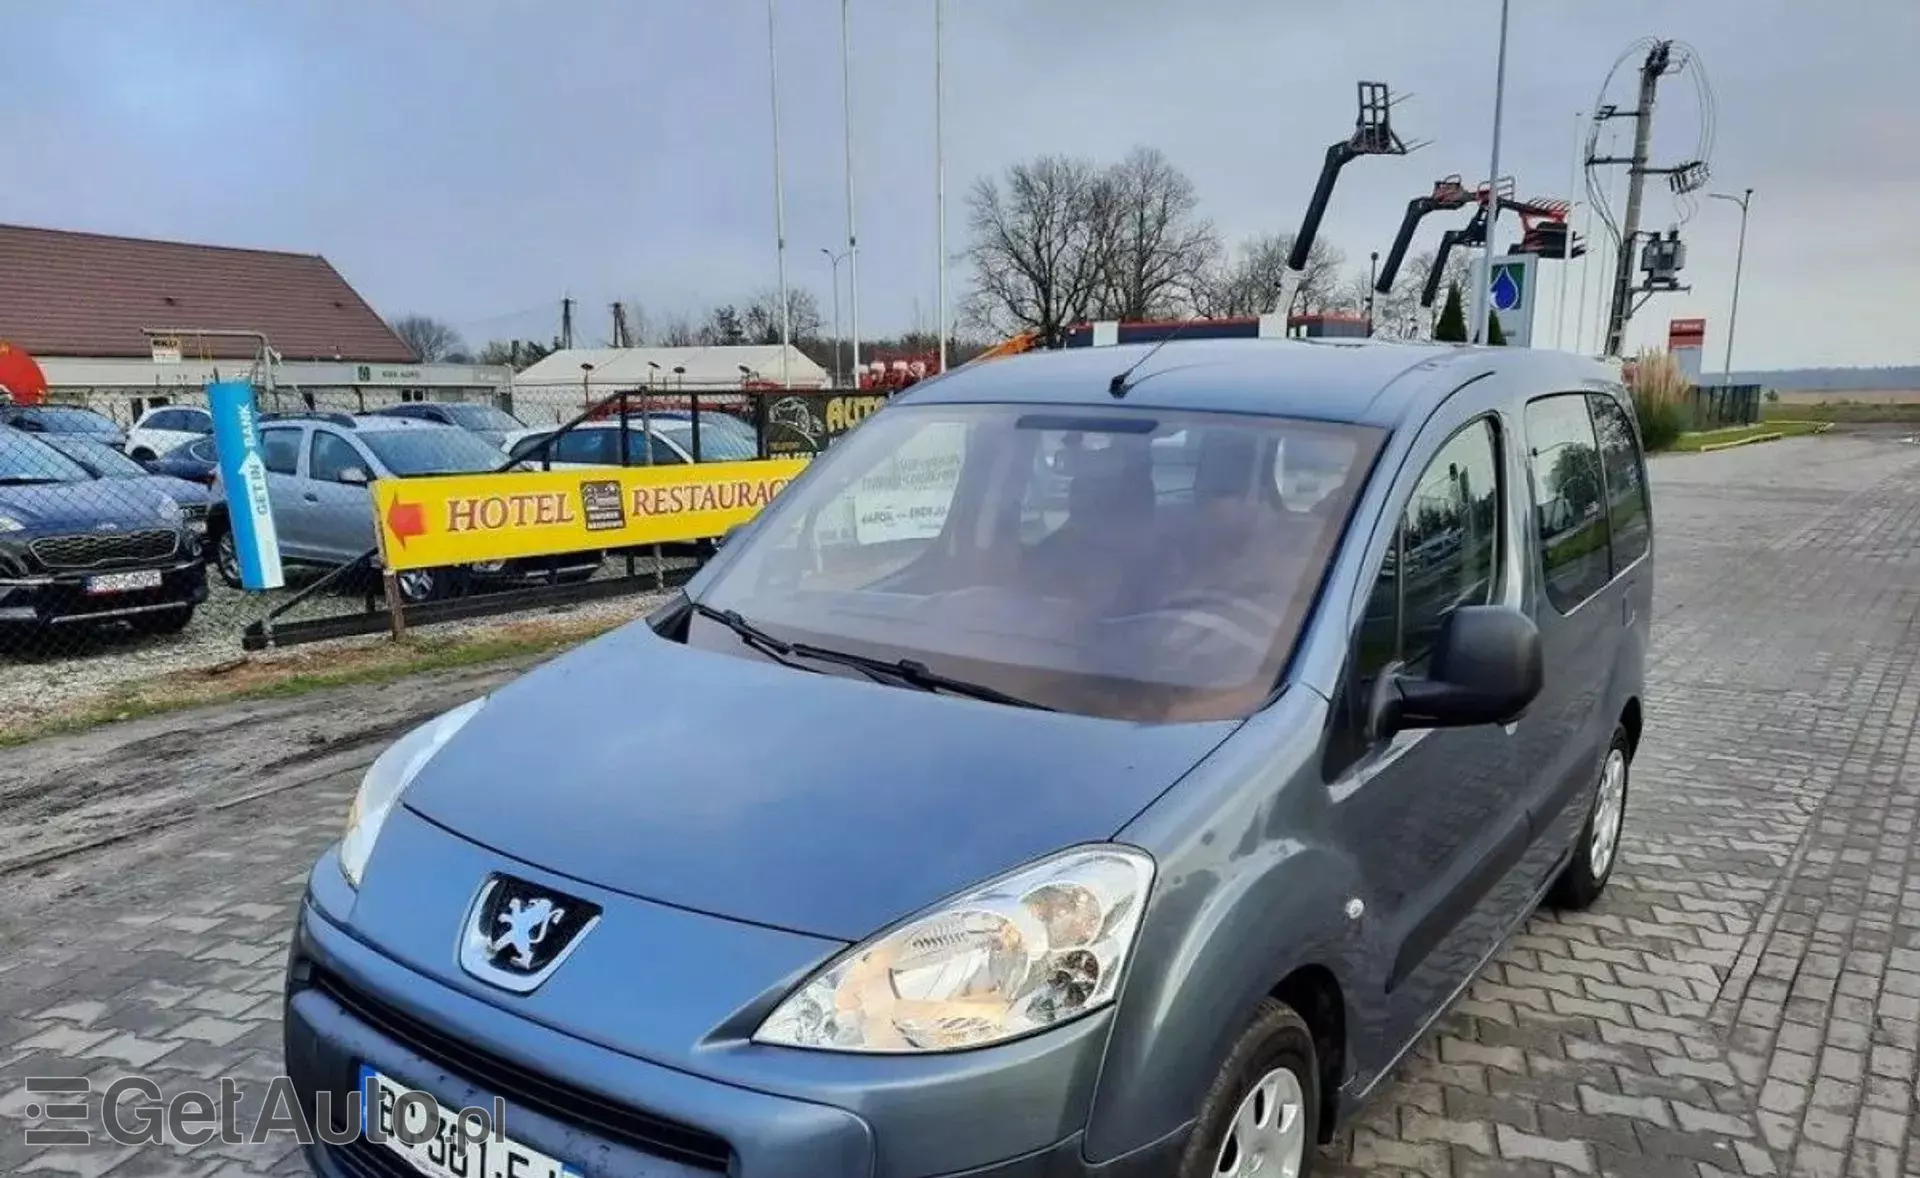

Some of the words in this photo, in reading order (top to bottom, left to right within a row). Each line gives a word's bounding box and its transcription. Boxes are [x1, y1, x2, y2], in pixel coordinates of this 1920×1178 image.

[237, 402, 257, 448] BANK
[447, 493, 575, 533] HOTEL
[632, 478, 790, 517] RESTAURAC
